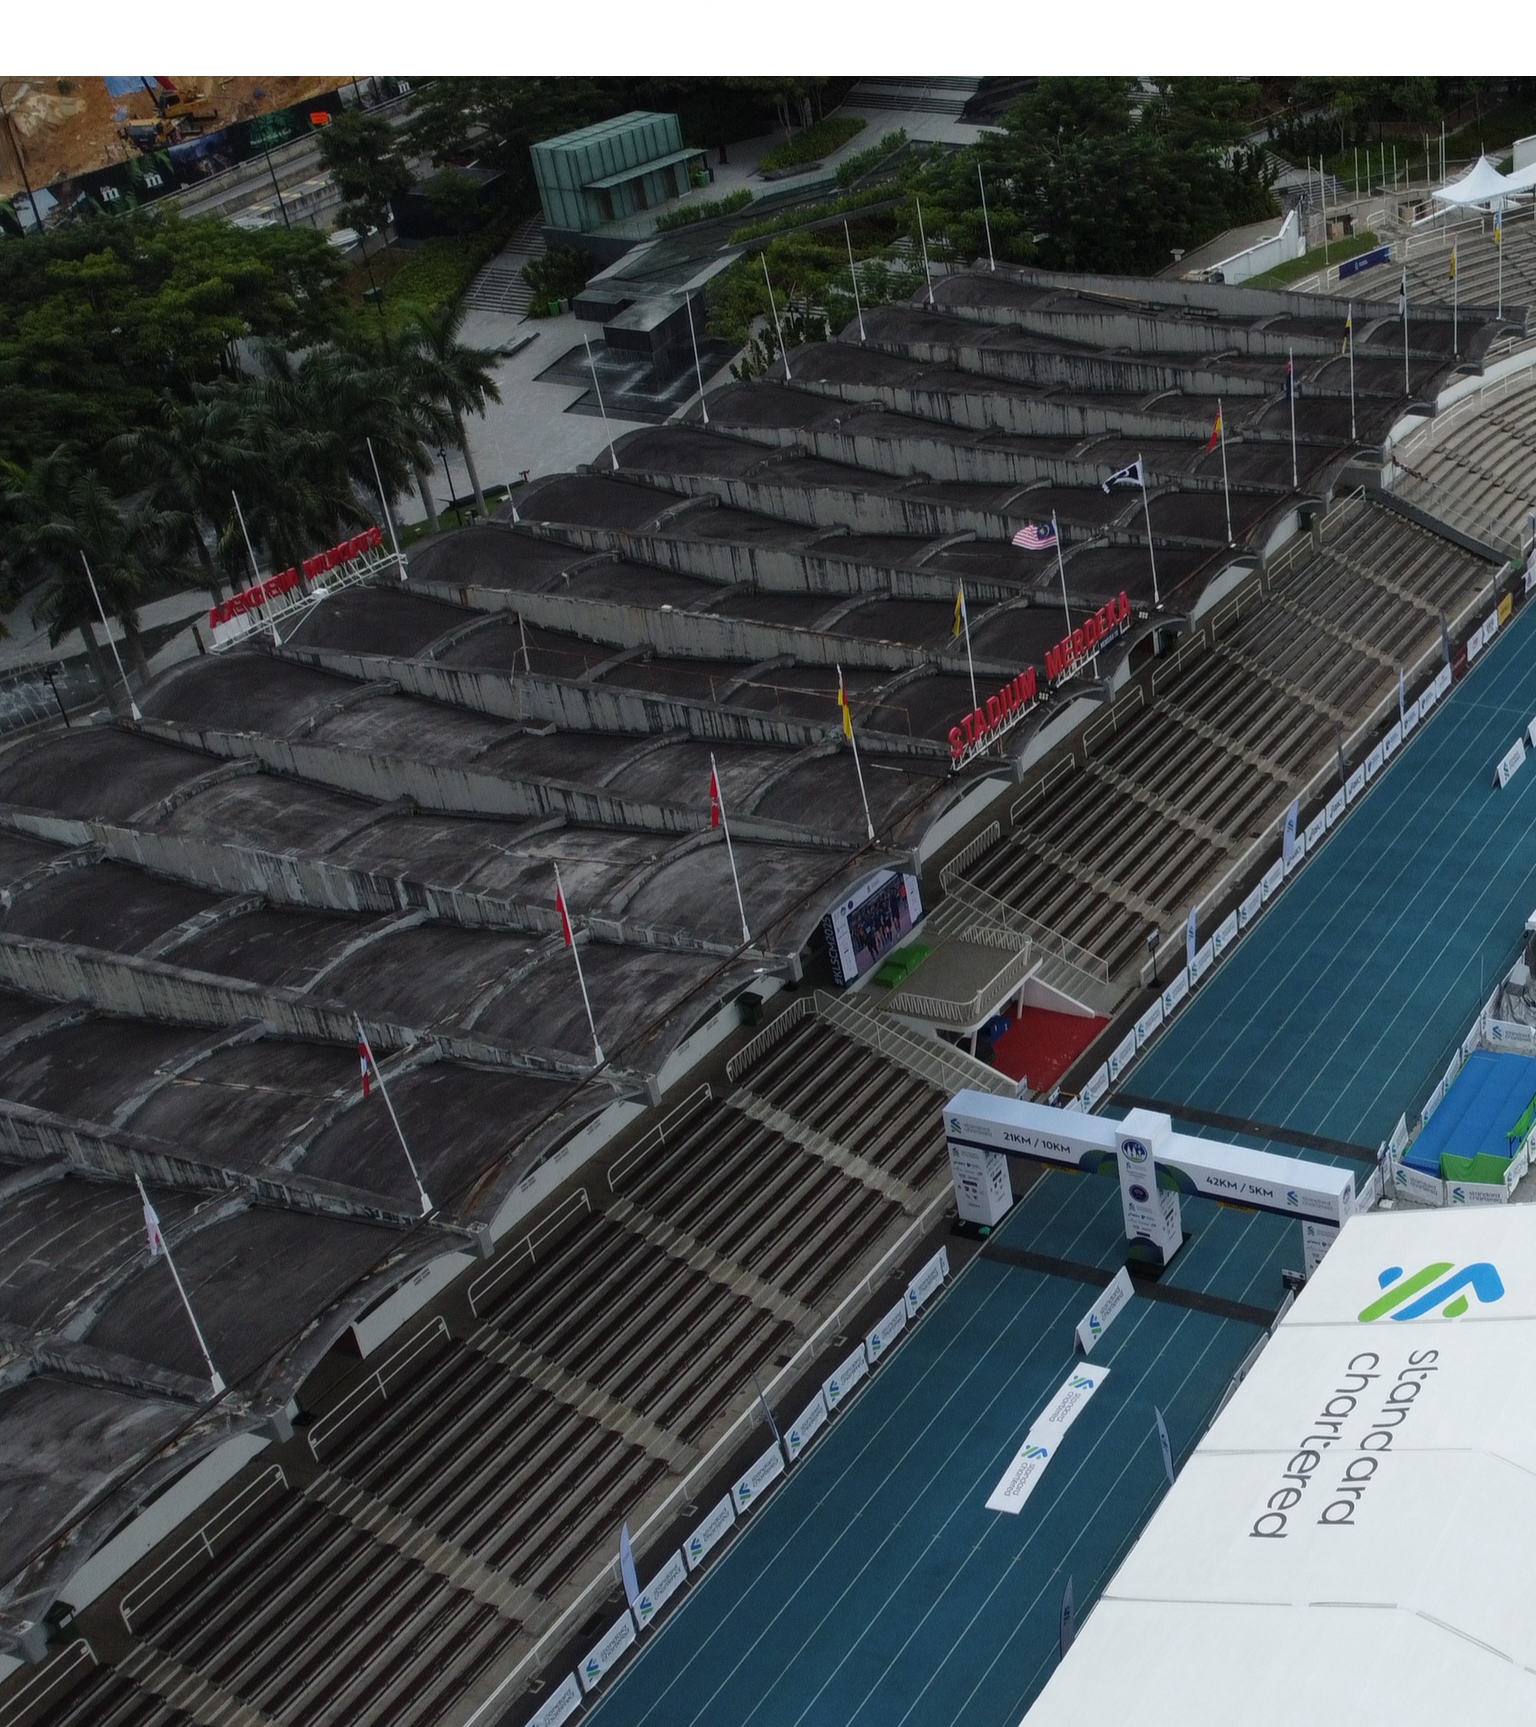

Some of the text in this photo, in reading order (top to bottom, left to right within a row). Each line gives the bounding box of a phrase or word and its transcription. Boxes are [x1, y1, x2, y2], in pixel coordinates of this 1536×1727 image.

[949, 590, 1130, 760] STADIUM MERDEKA
[1002, 1129, 1033, 1148] 21KM
[1040, 1138, 1071, 1156] 10KM
[1206, 1173, 1236, 1191] 42KM
[1249, 1180, 1274, 1199] 5KM
[1250, 1348, 1380, 1540] chartered
[1316, 1346, 1440, 1527] standard
